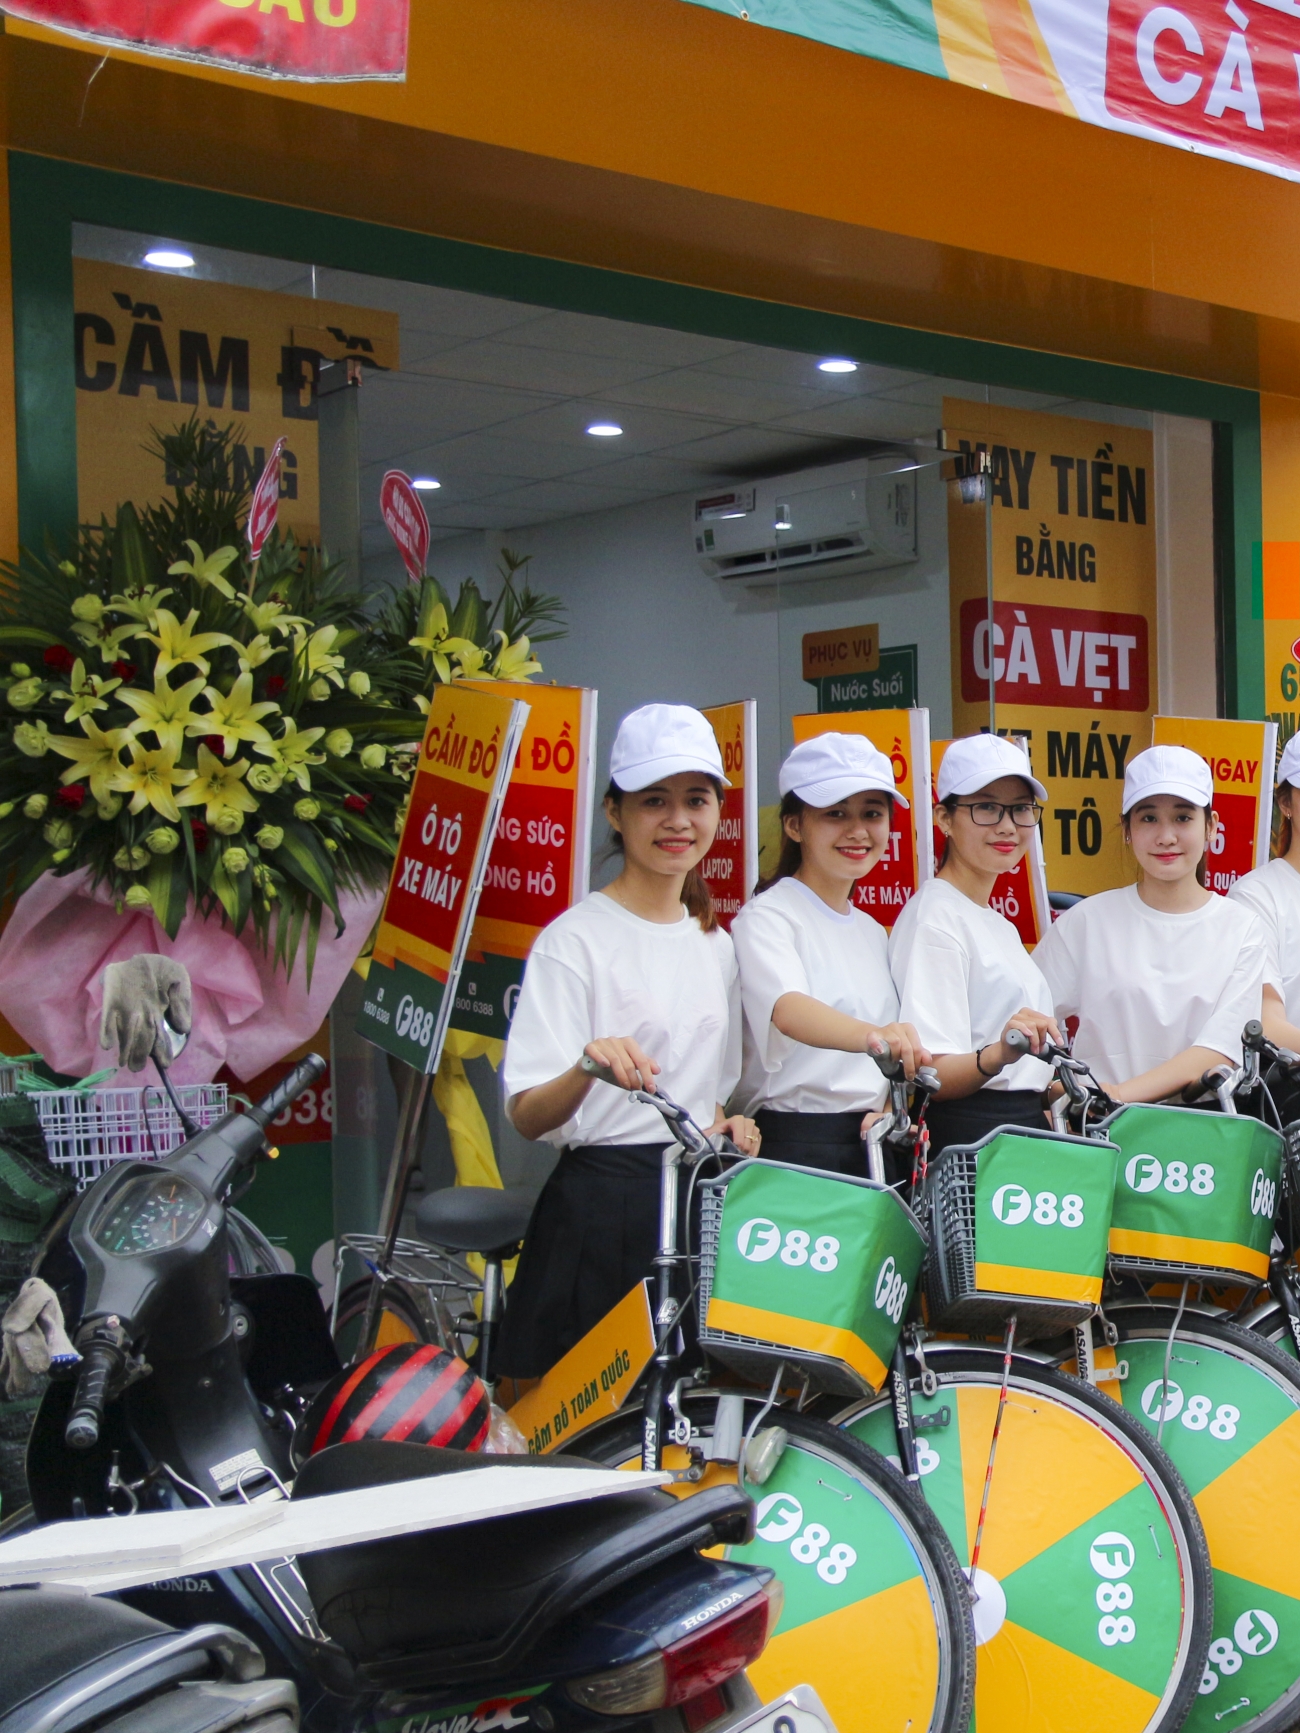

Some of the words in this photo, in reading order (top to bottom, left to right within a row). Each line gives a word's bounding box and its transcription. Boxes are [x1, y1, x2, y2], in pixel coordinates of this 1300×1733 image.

[1136, 0, 1264, 131] CÀ
[73, 291, 250, 413] CẦM
[958, 439, 1036, 510] VAY
[1050, 442, 1147, 526] TIỀN
[1015, 522, 1097, 583] BẰNG
[809, 645, 848, 667] PHỤC
[854, 638, 873, 663] VỤ
[972, 610, 1041, 686] CÀ
[1050, 627, 1137, 702] VẸT
[831, 679, 868, 701] Nước
[872, 672, 903, 696] Suối
[425, 712, 468, 778] CẦM
[468, 725, 501, 779] ĐỒ
[531, 721, 575, 774] ĐỒ
[725, 723, 743, 773] ĐỒ
[1047, 721, 1131, 780] MÁY
[421, 803, 438, 846] Ô
[441, 812, 463, 856] TÔ
[526, 815, 565, 847] SỨC
[1054, 797, 1103, 856] TÔ
[398, 856, 422, 892] XE
[421, 865, 462, 911] MÁY
[527, 860, 556, 896] HỒ
[702, 858, 733, 880] LAPTOP
[858, 885, 876, 905] XE
[880, 881, 912, 905] MÁY
[364, 1001, 378, 1016] 1800
[376, 1008, 391, 1025] 6388
[396, 994, 435, 1047] F88
[454, 997, 471, 1010] 800
[473, 1001, 493, 1016] 6388
[1124, 1153, 1216, 1196] F88
[1250, 1167, 1276, 1219] F88
[992, 1183, 1084, 1229] F88
[737, 1218, 840, 1273] F88
[875, 1255, 907, 1324] F88
[554, 1401, 570, 1437] ĐỒ
[570, 1379, 599, 1420] TOÀN
[601, 1349, 631, 1392] QUỐC
[893, 1371, 908, 1429] ASAMA
[1141, 1379, 1241, 1440] F88
[645, 1417, 657, 1471] ASAM
[755, 1492, 857, 1585] F88
[681, 1592, 744, 1630] HONDA
[1090, 1531, 1136, 1646] F88
